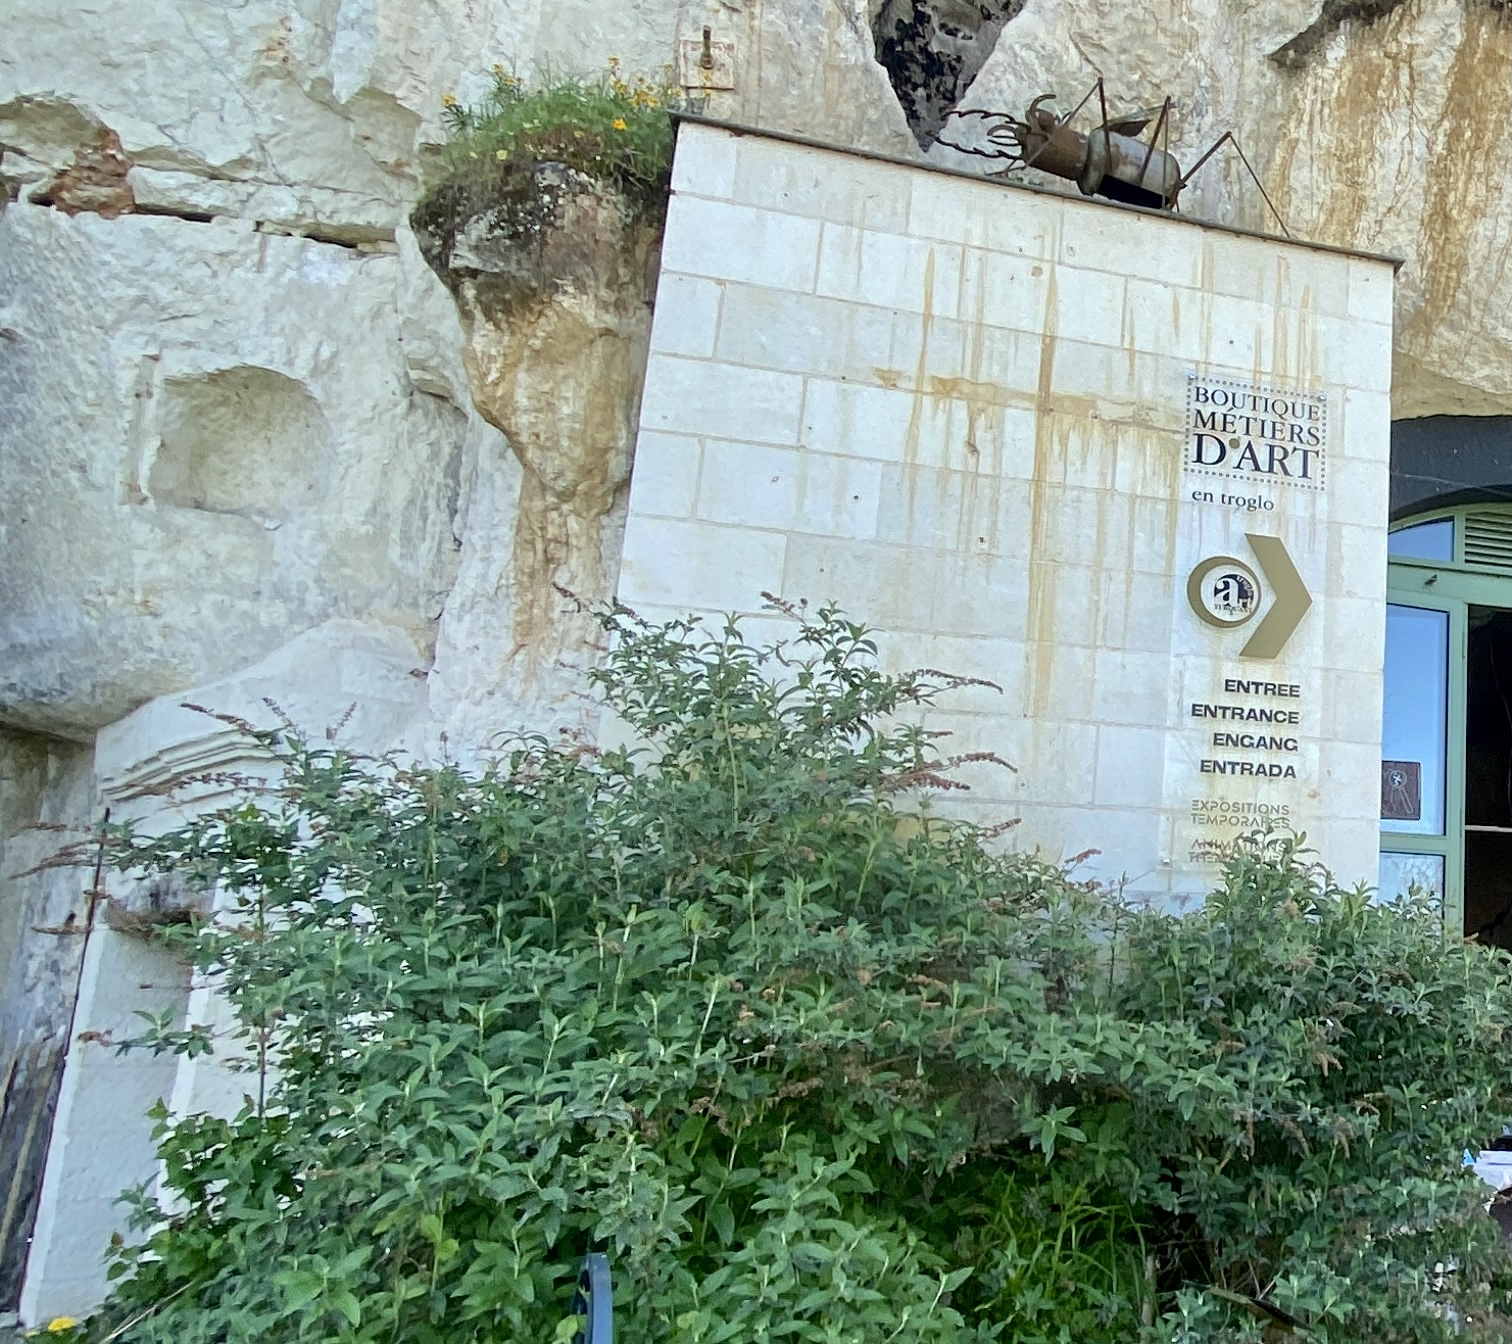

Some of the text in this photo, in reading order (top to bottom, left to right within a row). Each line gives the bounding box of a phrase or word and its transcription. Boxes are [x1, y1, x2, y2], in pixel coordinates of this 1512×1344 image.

[1194, 386, 1320, 421] BOUTIQUE
[1193, 407, 1320, 447] MÉTIERS
[1192, 490, 1274, 512] en troglo
[1224, 679, 1300, 698] ENTREE
[1191, 703, 1300, 725] ENTRANCE
[1213, 732, 1298, 752] ENGANG
[1200, 759, 1296, 779] ENTRADA
[1191, 799, 1290, 815] EXPOSITIONS
